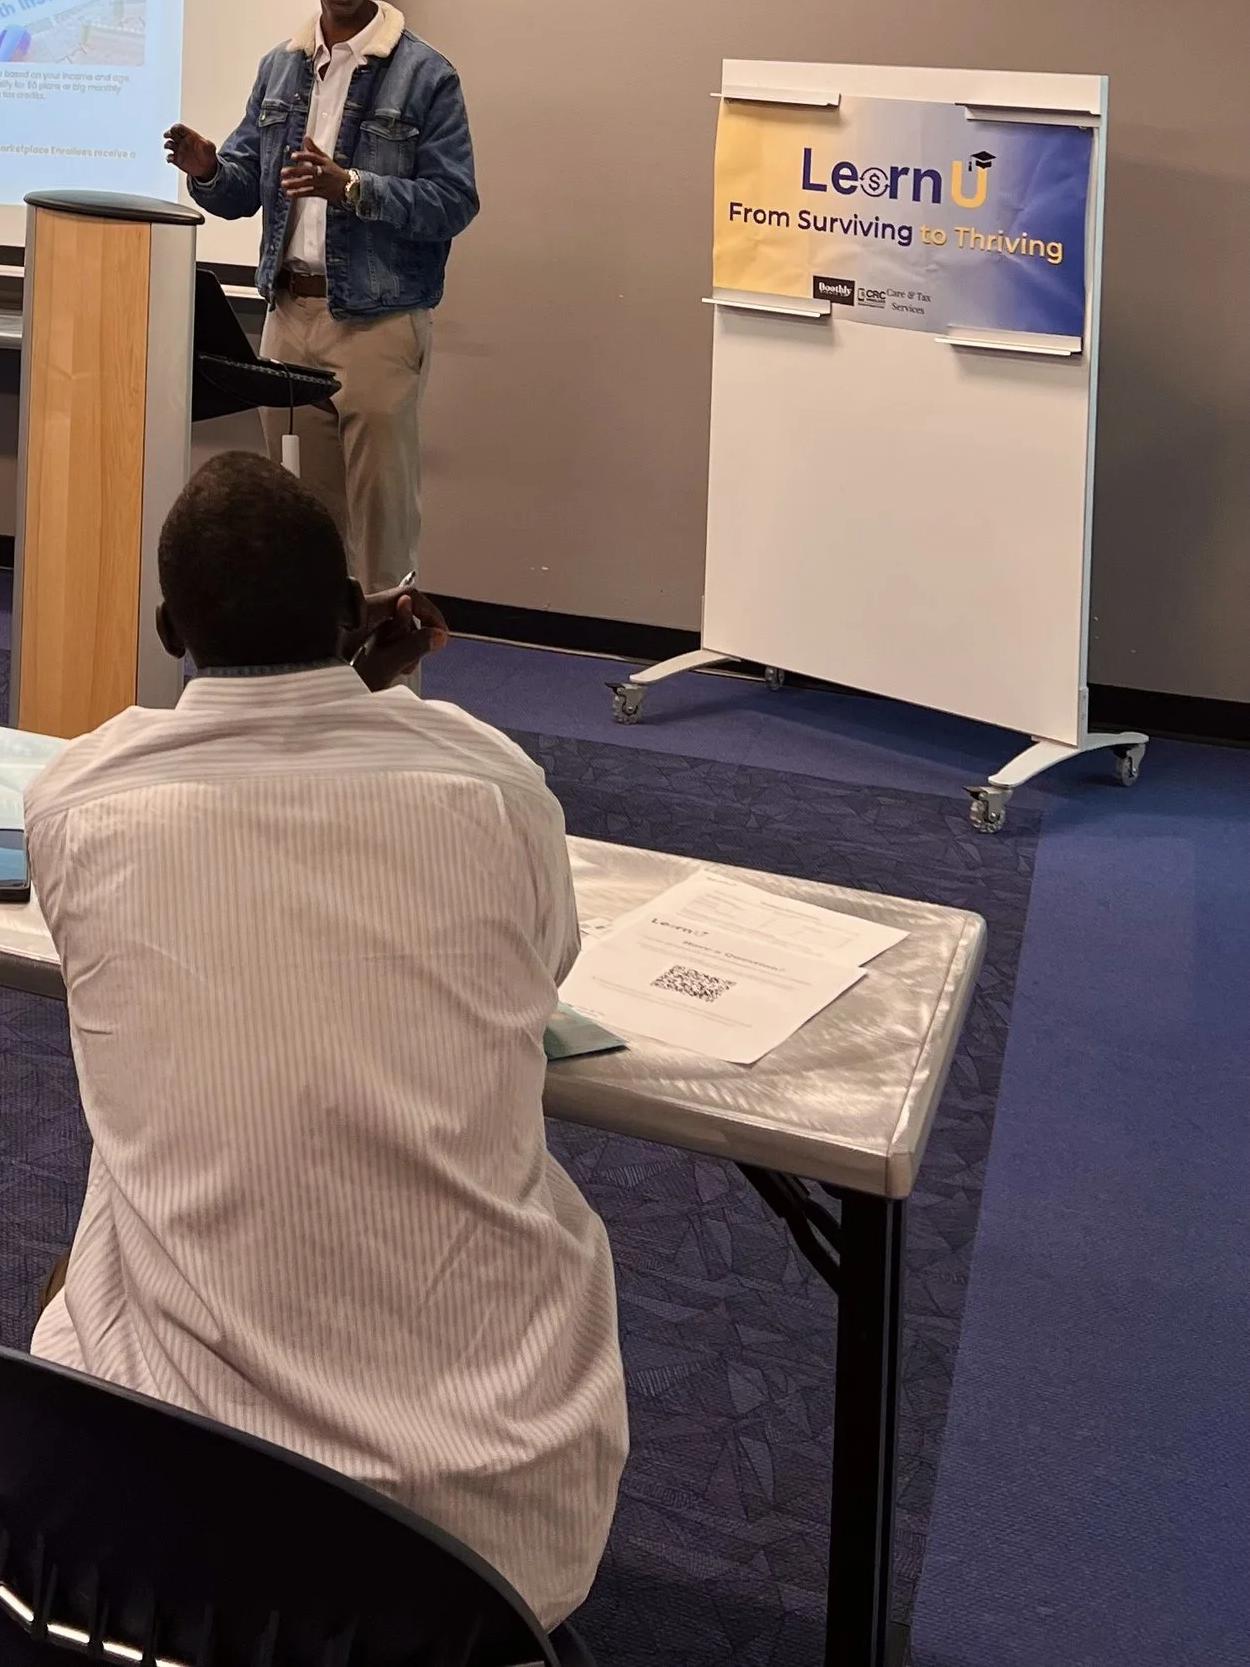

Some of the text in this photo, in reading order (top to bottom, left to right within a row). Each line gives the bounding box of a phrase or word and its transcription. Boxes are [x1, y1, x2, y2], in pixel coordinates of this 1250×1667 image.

[93, 148, 129, 159] receive
[728, 202, 1064, 265] From Surviving to Thriving
[865, 289, 886, 300] CRC
[886, 287, 932, 302] Care & Tax
[891, 302, 925, 315] Services
